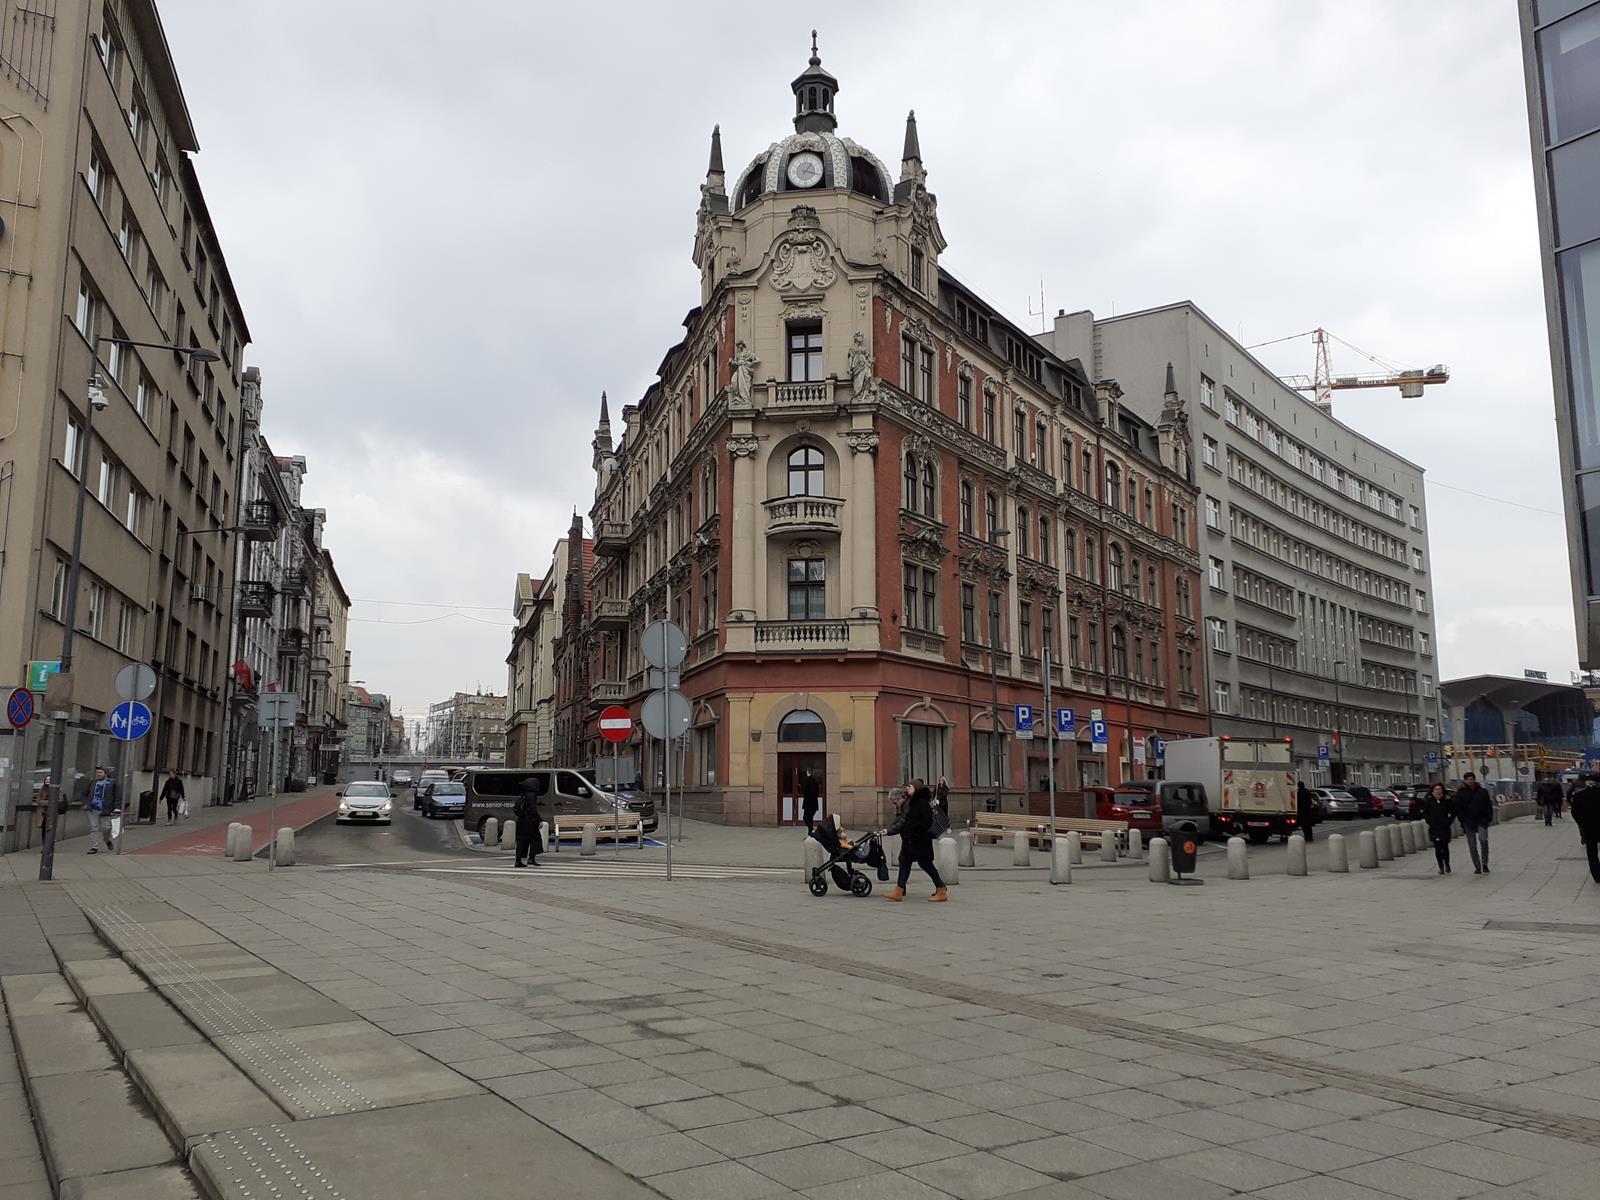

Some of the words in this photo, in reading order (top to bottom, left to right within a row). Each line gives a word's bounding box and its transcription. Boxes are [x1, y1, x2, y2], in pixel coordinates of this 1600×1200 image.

[1018, 706, 1029, 723] P
[1061, 709, 1071, 725] P
[1094, 722, 1104, 737] P
